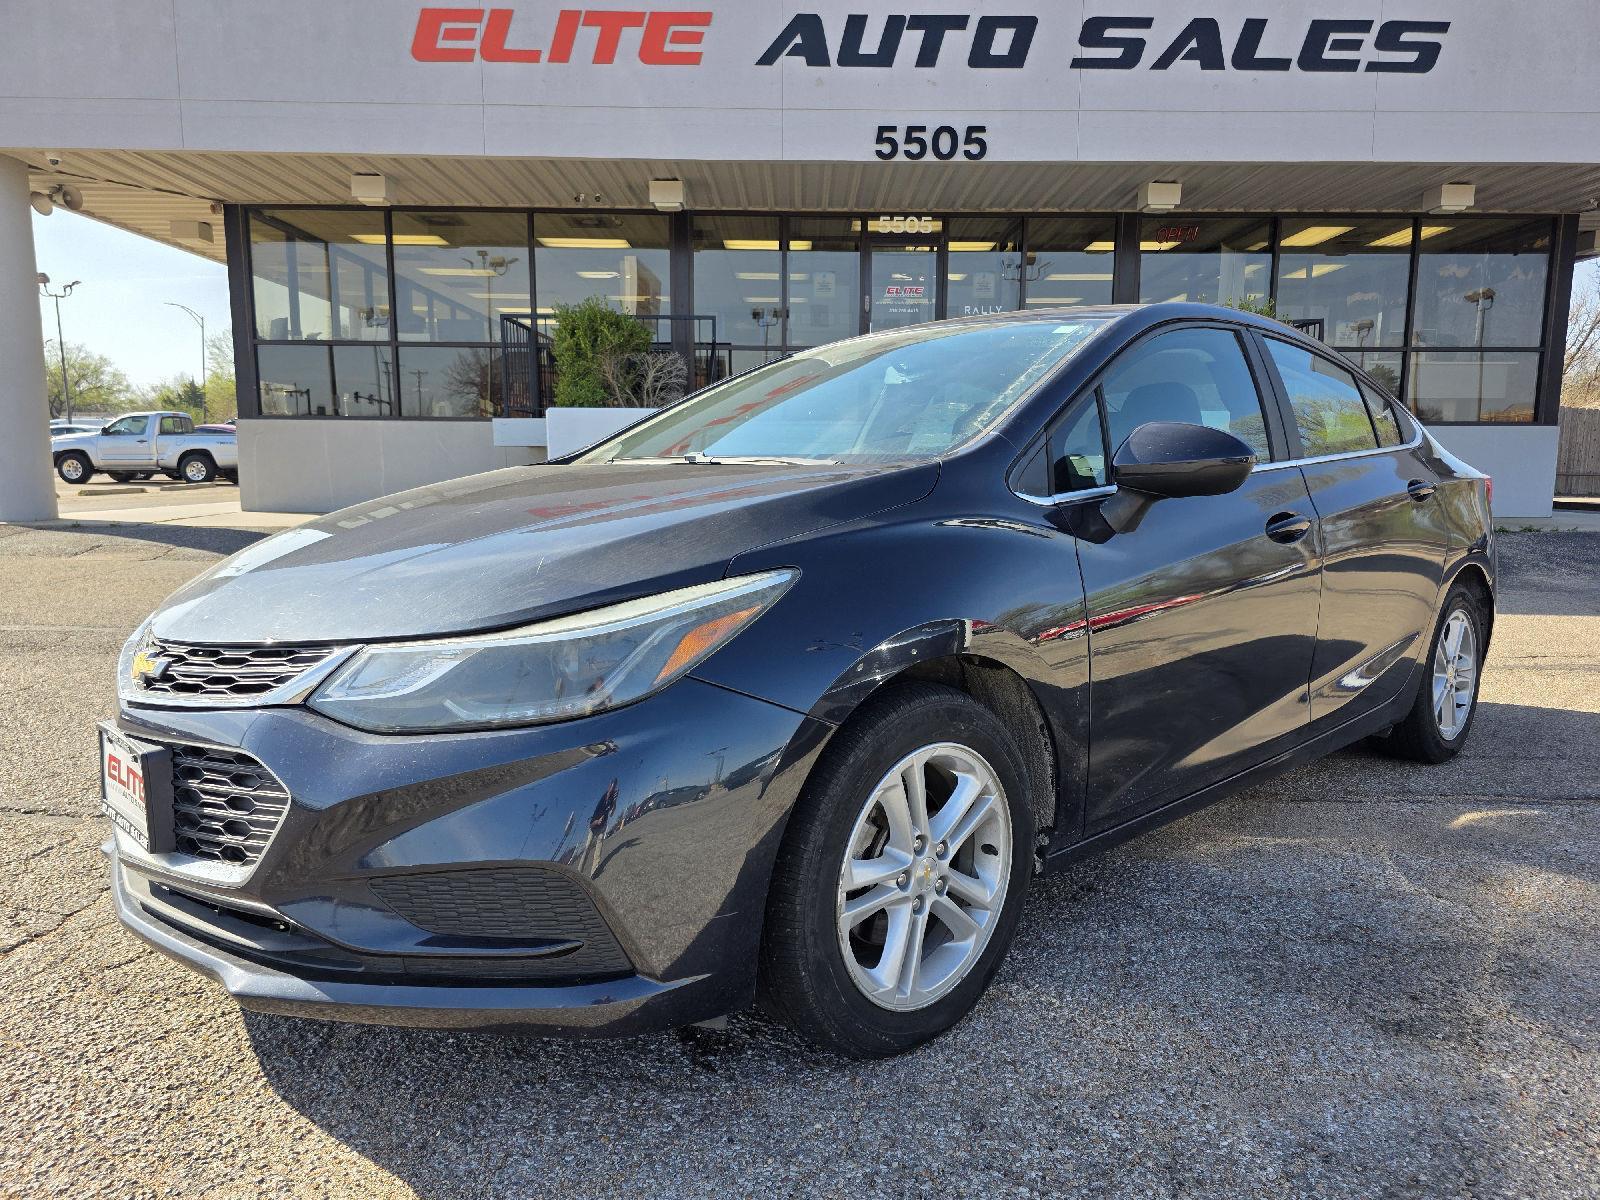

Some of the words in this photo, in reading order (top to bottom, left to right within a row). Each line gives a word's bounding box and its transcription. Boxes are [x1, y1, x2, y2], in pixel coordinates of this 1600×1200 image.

[411, 8, 712, 65] ELITE
[755, 13, 1038, 69] AUTO
[1070, 16, 1451, 74] SALES
[875, 125, 988, 161] 5505
[879, 216, 933, 234] 5505
[886, 286, 924, 295] ELITE
[964, 305, 1002, 316] RALLY
